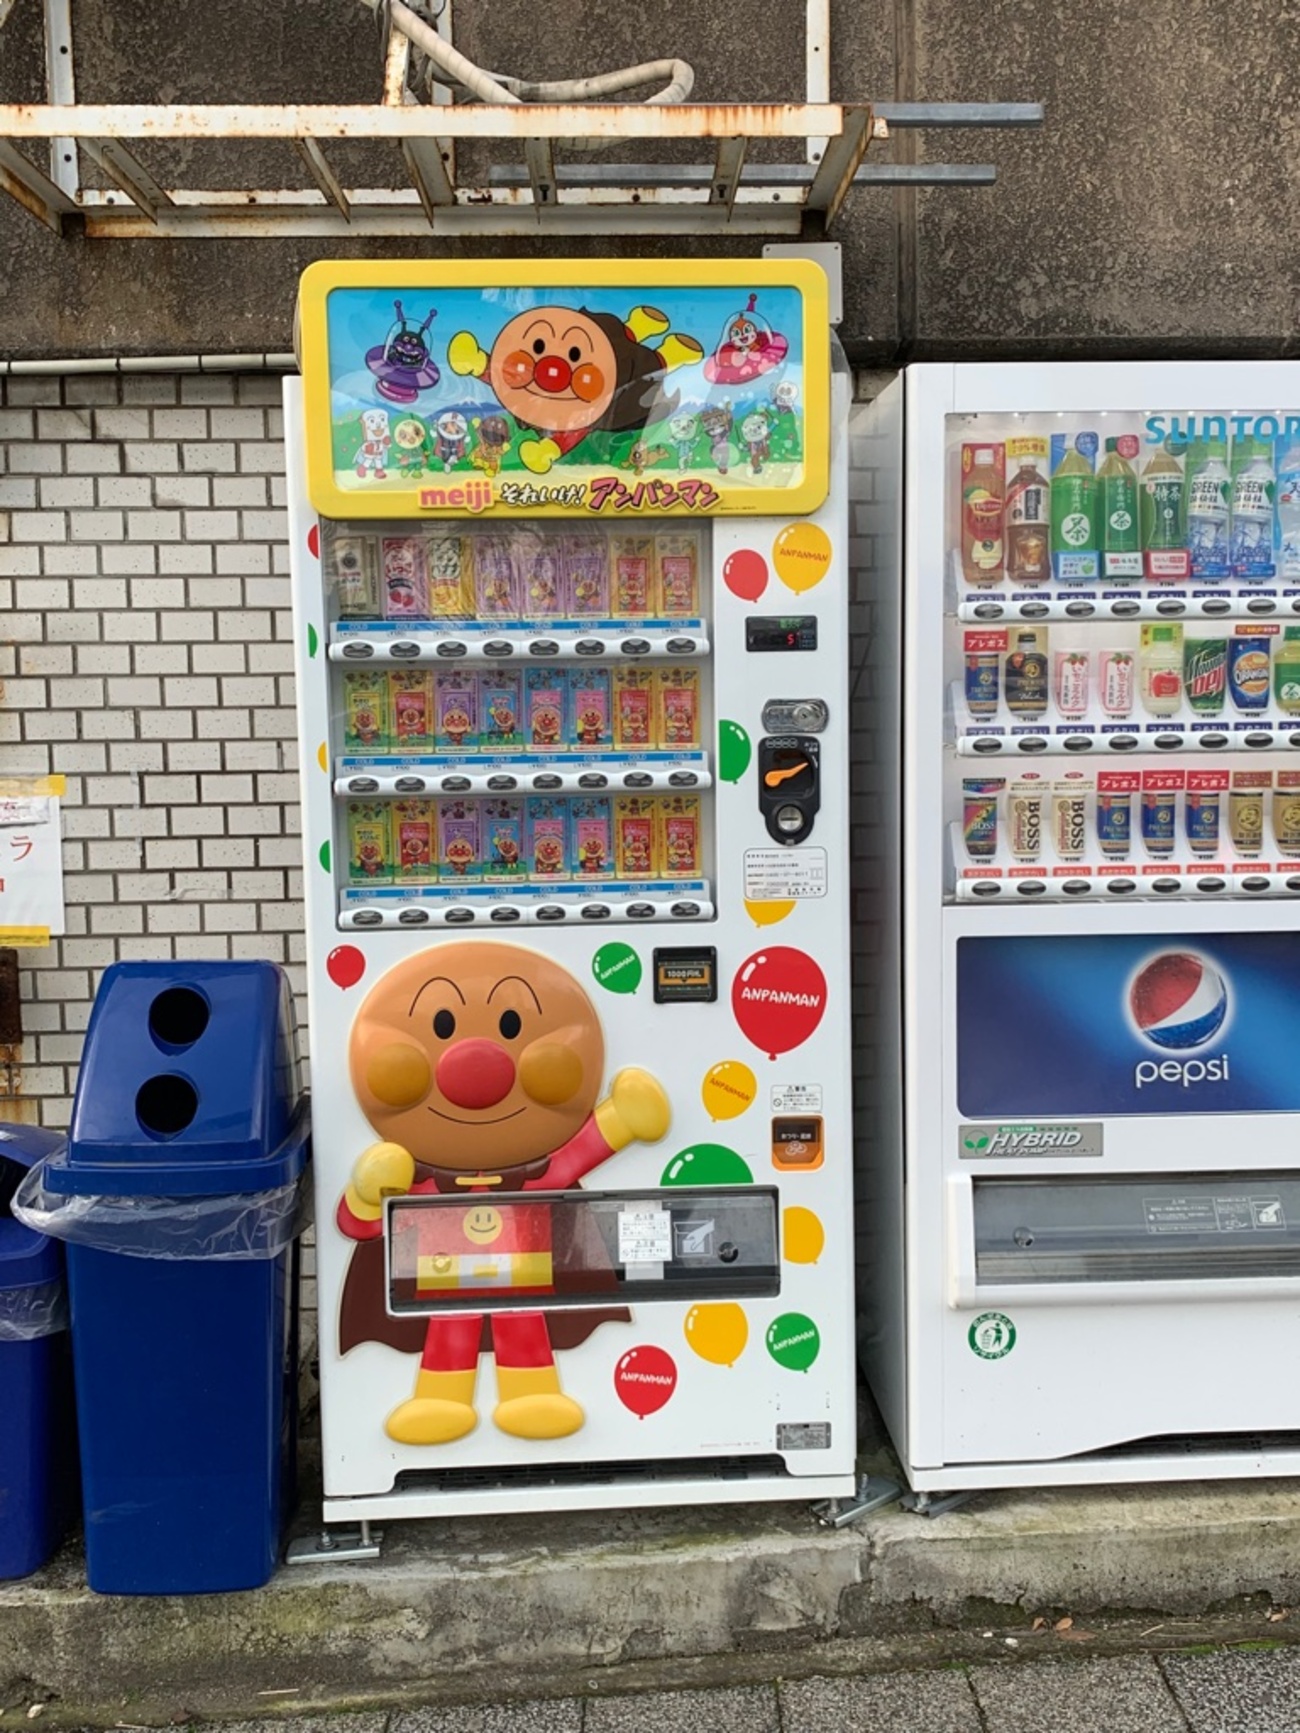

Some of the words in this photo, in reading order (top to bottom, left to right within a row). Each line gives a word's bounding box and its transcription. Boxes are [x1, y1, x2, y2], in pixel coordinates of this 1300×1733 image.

[420, 481, 491, 510] meiji
[502, 483, 585, 507] それいけ!
[587, 477, 719, 511] アンパンマン
[1191, 481, 1220, 494] GREEN
[1235, 481, 1264, 494] GREEN
[780, 547, 828, 562] ANPANMAN
[1027, 801, 1040, 851] BOSS
[1070, 800, 1085, 850] BOSS
[600, 954, 636, 980] ANPANMAN
[741, 987, 820, 1007] ANPANMAN
[1135, 1054, 1229, 1088] pepsi
[709, 1077, 750, 1102] ANPANMAN
[986, 1132, 1082, 1156] HYBRID
[773, 1329, 815, 1351] ANPANMAN
[620, 1371, 673, 1386] ANPANMAN
